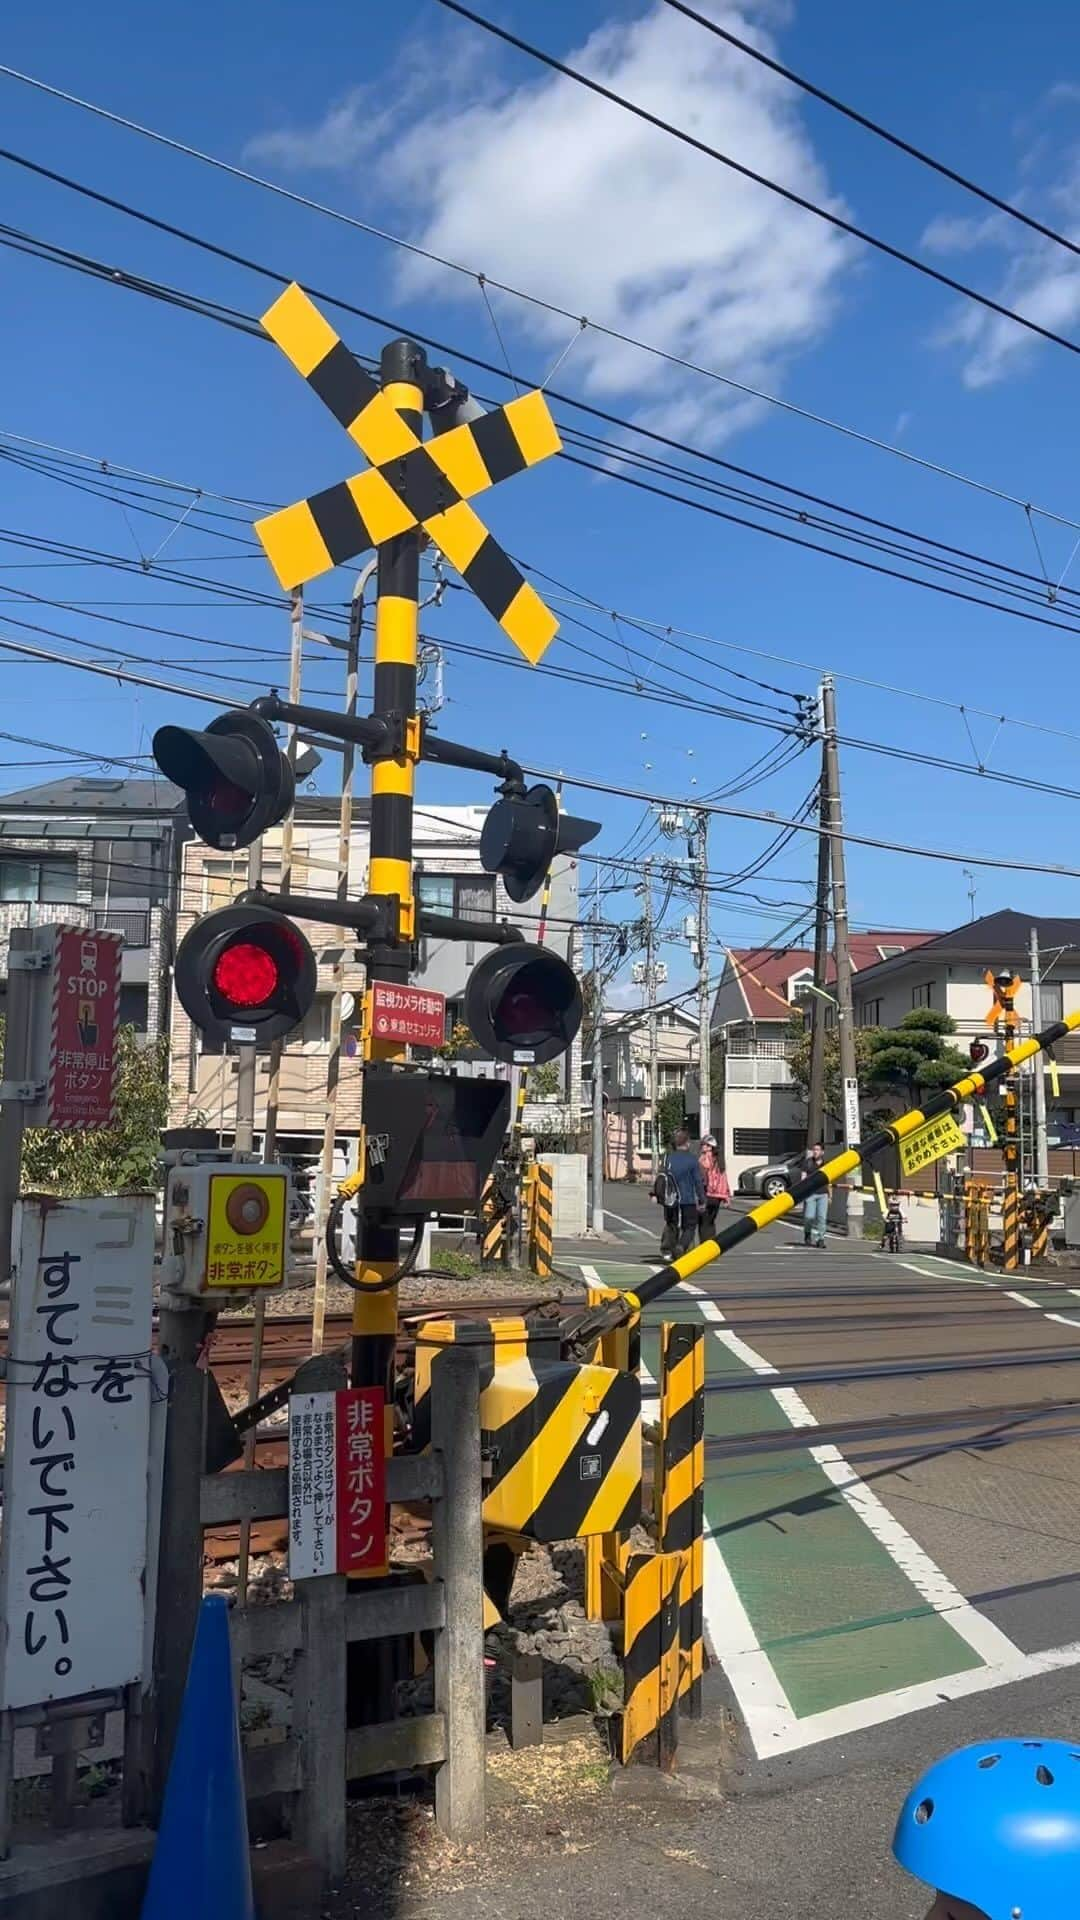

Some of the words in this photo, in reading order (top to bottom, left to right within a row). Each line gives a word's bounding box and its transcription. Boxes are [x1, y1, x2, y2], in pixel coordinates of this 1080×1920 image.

[67, 976, 107, 998] STOP
[376, 989, 442, 1016] 監視カメラ作動中
[390, 1018, 441, 1038] 東急セキュリティ
[58, 1050, 111, 1071] 非常停止
[64, 1071, 103, 1089] ボタン
[908, 1134, 960, 1170] おやめ下さい
[209, 1261, 281, 1281] 非常ボタン
[25, 1251, 81, 1676] すてないで下さい。
[346, 1399, 374, 1558] 非常ボタン
